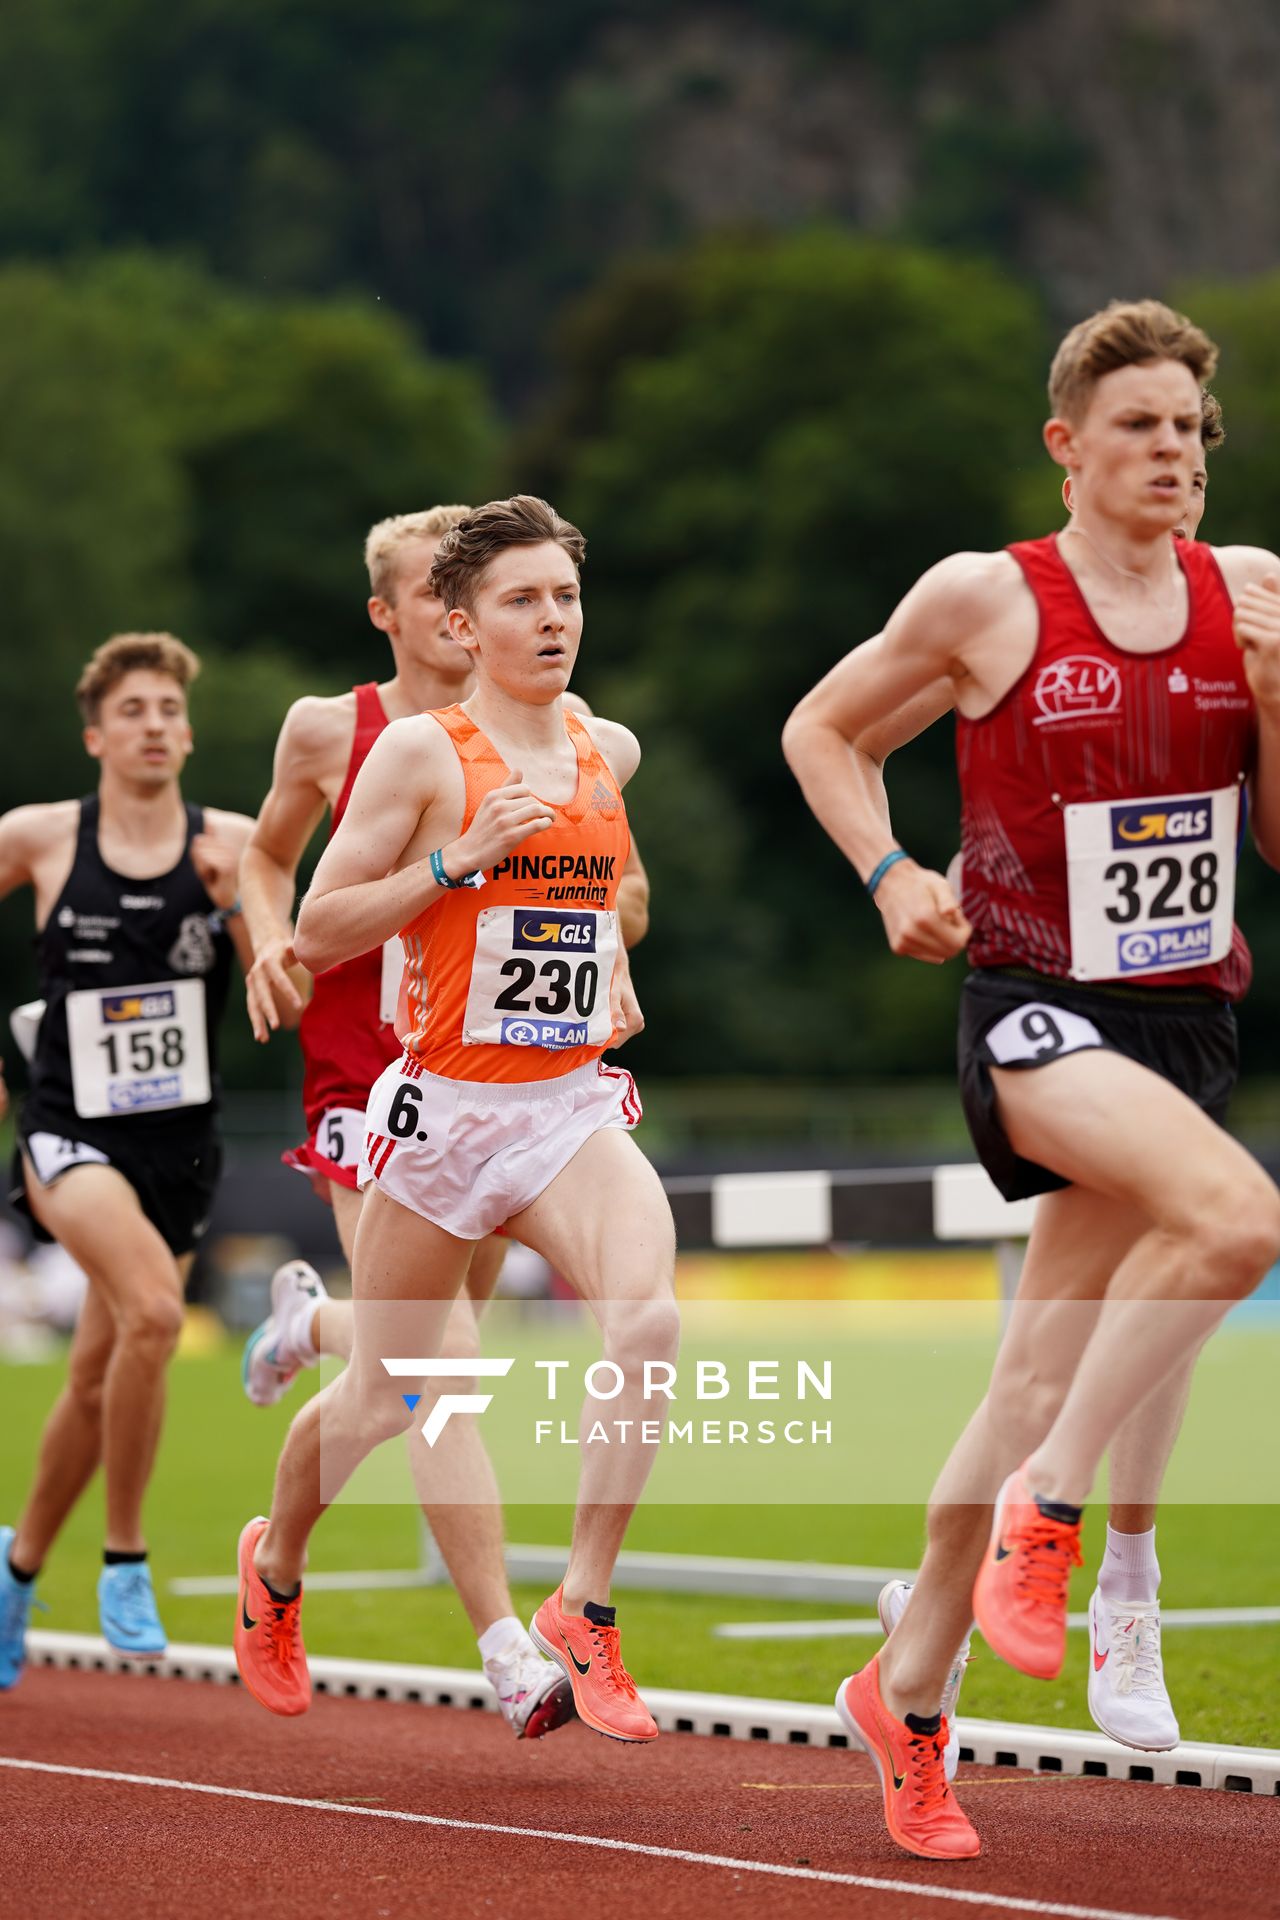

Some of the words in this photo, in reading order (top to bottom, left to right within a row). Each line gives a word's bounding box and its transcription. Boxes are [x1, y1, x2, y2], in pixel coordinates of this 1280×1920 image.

[1166, 810, 1207, 838] GLS
[493, 856, 615, 880] PINGPANK
[546, 881, 607, 906] running
[1105, 852, 1218, 923] 328
[560, 924, 591, 944] GLS
[1159, 927, 1209, 954] PLAN
[494, 957, 598, 1018] 230
[99, 1027, 184, 1075] 158
[542, 1026, 585, 1044] PLAN
[1021, 1011, 1064, 1060] 9
[387, 1083, 428, 1141] 6.
[327, 1116, 344, 1163] 5
